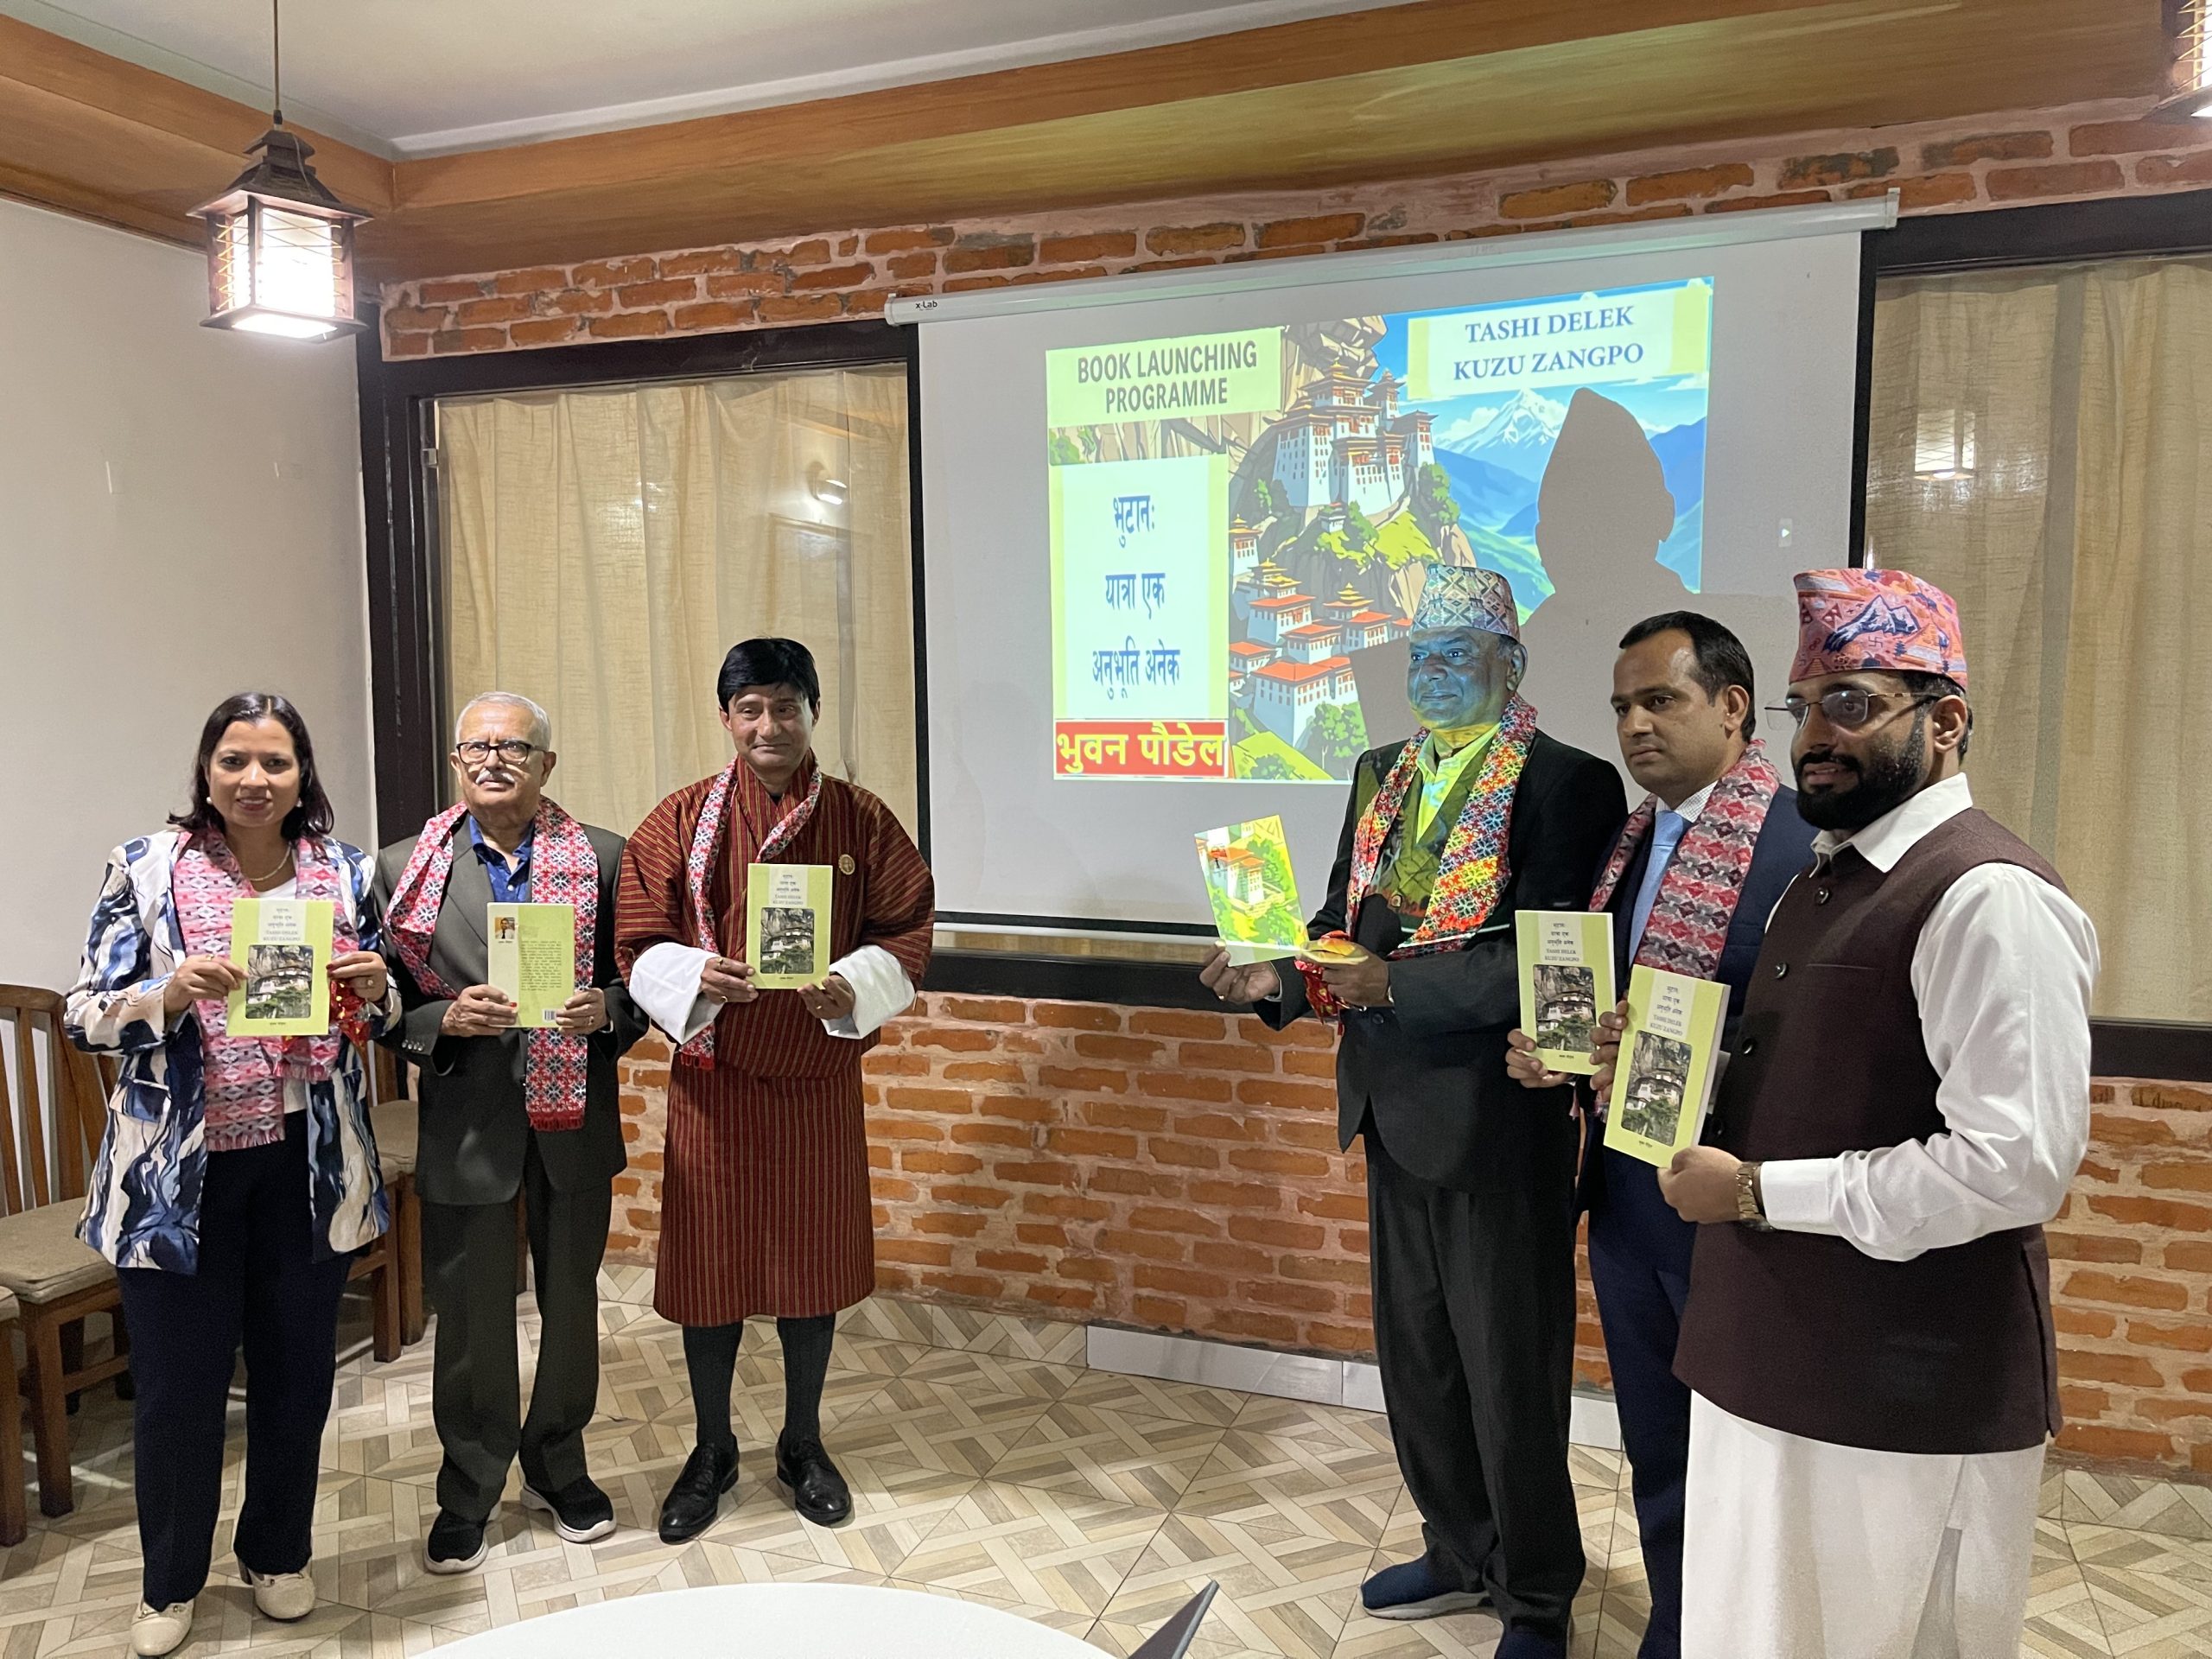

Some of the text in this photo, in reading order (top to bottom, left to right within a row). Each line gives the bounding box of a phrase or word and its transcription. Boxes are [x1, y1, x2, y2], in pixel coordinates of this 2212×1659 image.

[1465, 305, 1635, 343] TASHI DELEK
[1077, 340, 1257, 384] BOOK LAUNCHING
[1453, 343, 1644, 381] KUZU ZANGPO
[1105, 378, 1228, 414] PROGRAMME
[1105, 572, 1166, 619] यात्रा एक
[1092, 635, 1181, 699] अनुभूति अनेक
[1057, 721, 1225, 774] भुवन पौडेल
